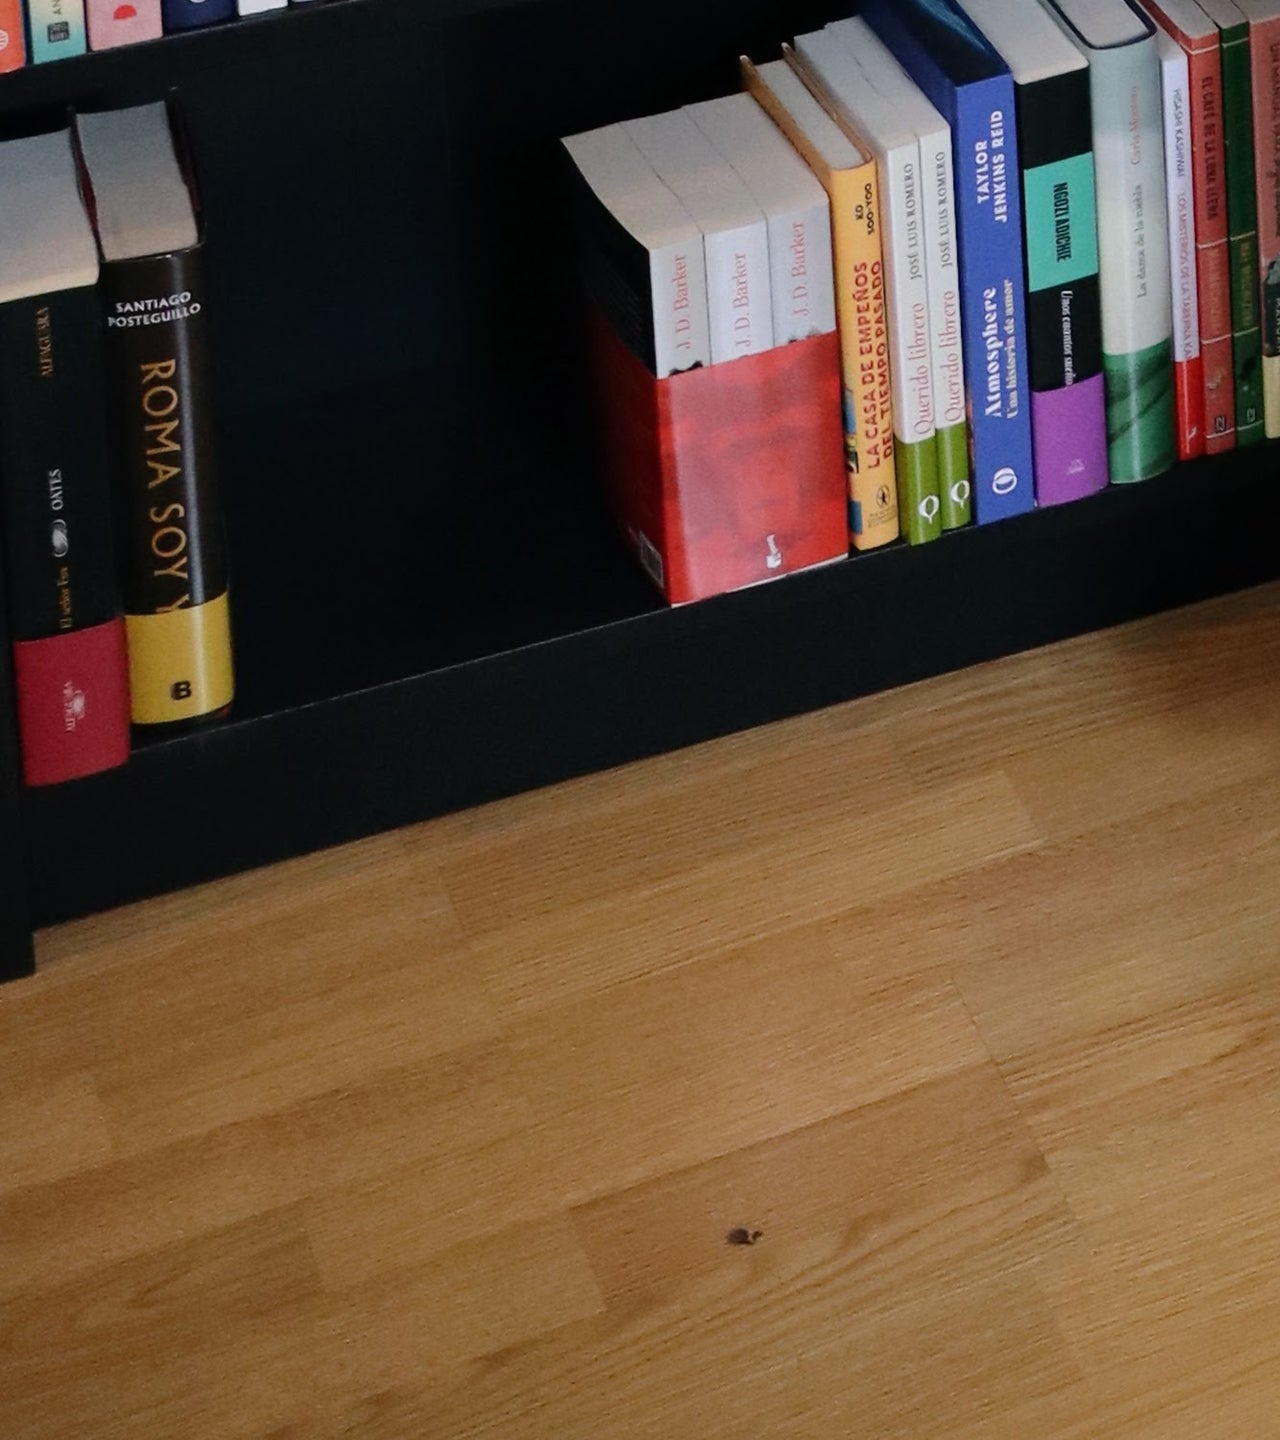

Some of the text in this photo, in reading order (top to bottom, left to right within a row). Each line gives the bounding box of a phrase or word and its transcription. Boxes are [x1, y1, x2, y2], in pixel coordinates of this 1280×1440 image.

[975, 140, 991, 204] TAYLOR
[990, 110, 1009, 224] JENKINS REID
[108, 302, 201, 328] POSTEGUILLO
[115, 291, 191, 315] SANTIAGO
[983, 287, 1005, 418] Atmosphere
[141, 360, 188, 581] ROMA SOY
